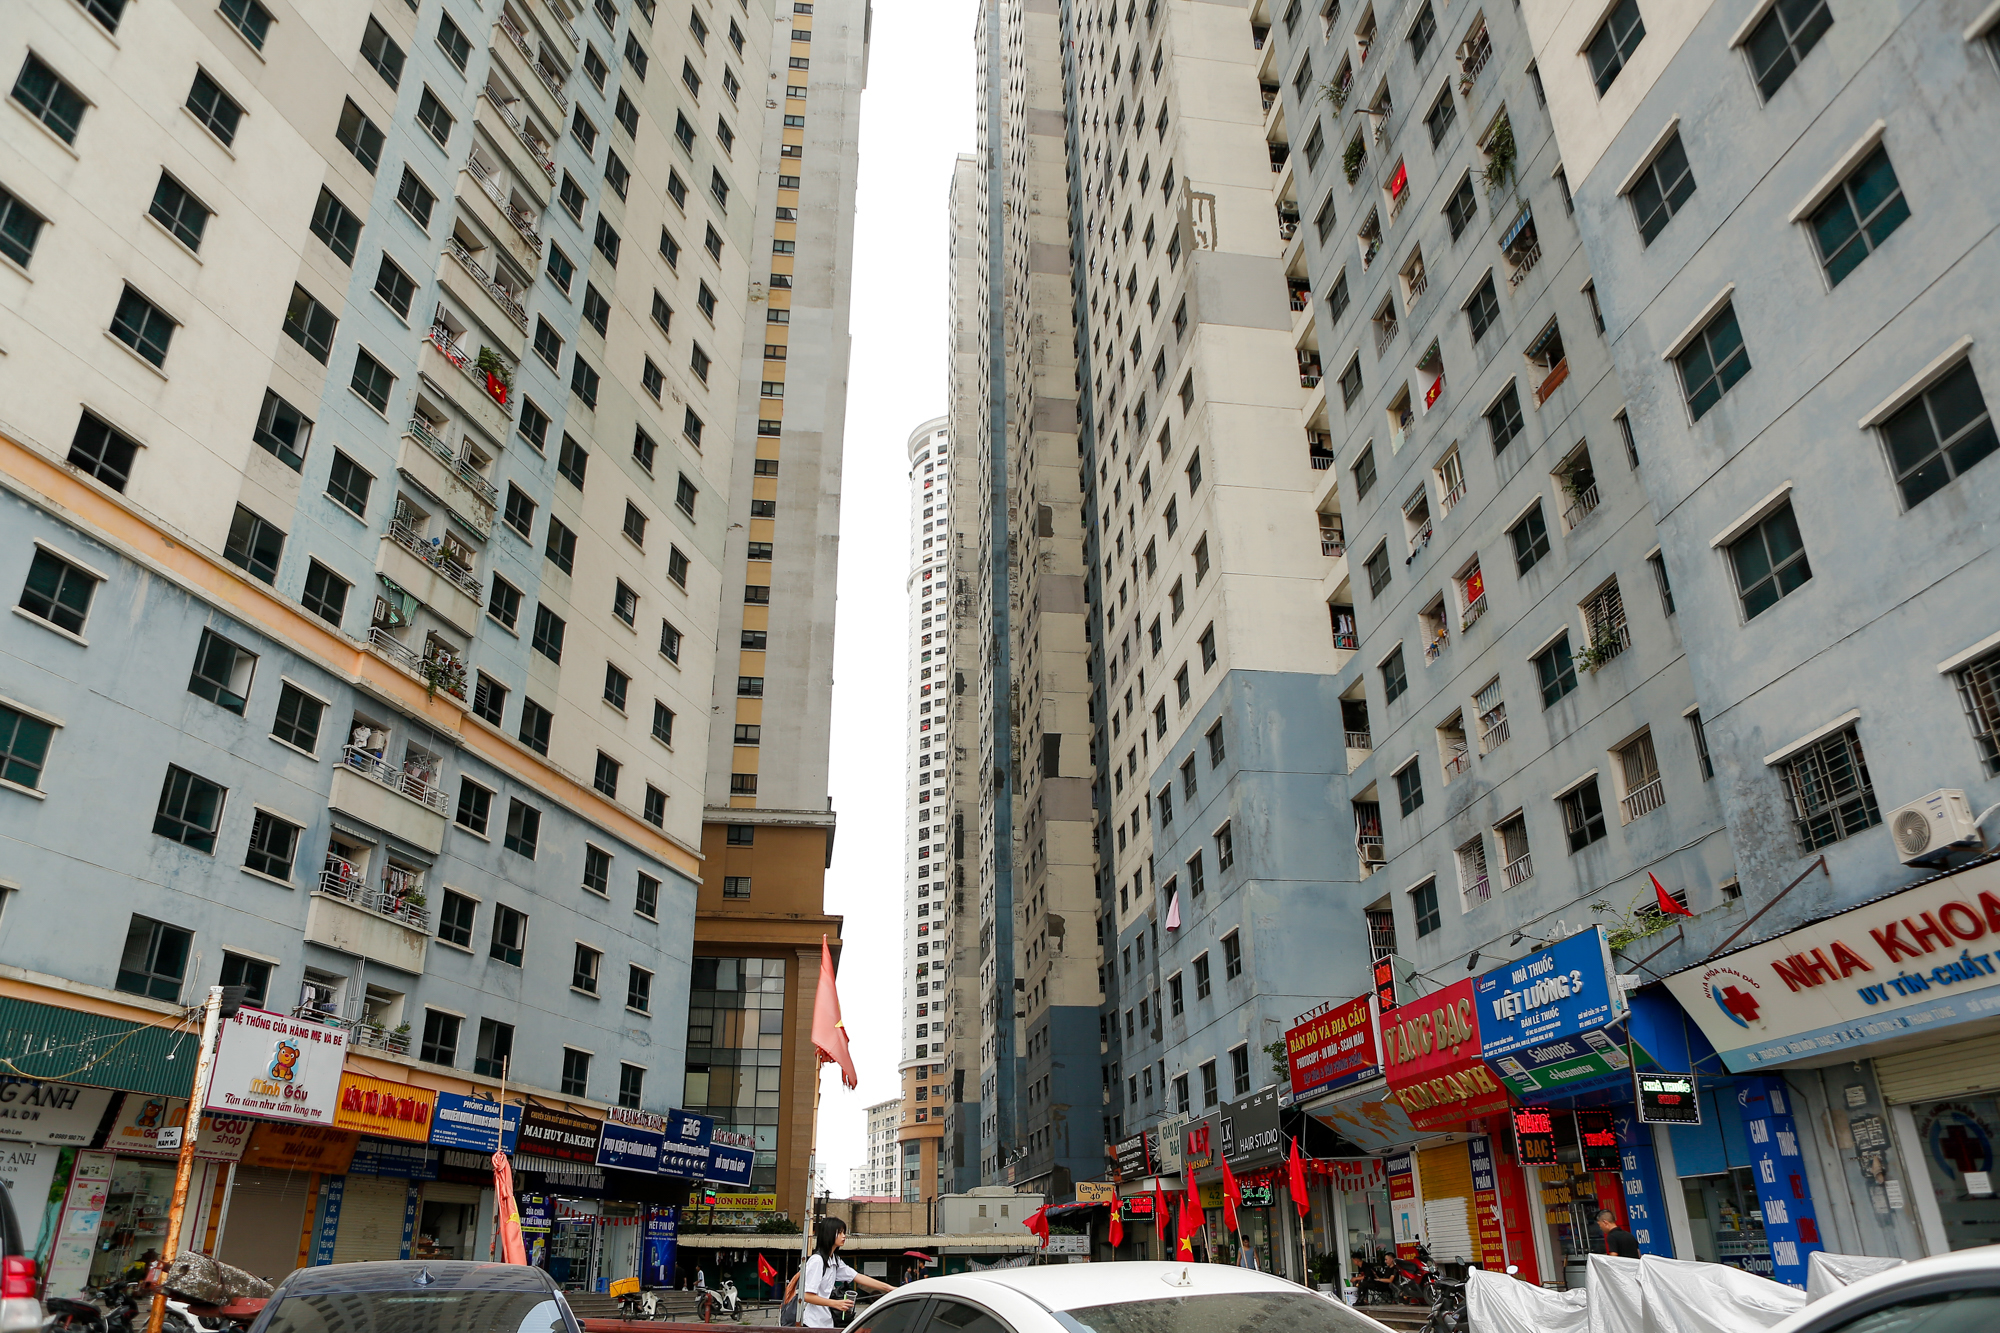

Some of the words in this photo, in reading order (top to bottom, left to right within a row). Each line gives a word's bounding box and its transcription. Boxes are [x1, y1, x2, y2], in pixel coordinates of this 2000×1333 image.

[1770, 939, 1874, 993] NHA
[1868, 889, 2000, 964] KHOA
[1512, 965, 1528, 985] NHÀ
[1528, 953, 1554, 979] THUỐC
[1492, 989, 1522, 1022] VIỆT
[1523, 975, 1570, 1011] LƯƠNG
[1569, 969, 1584, 994] 3
[1857, 983, 1890, 1006] UY
[233, 1012, 244, 1026] HỆ
[246, 1015, 271, 1030] THỐNG
[272, 1019, 287, 1034] CỬA
[289, 1024, 309, 1039] HÀNG
[311, 1030, 322, 1043] MẸ
[324, 1032, 332, 1044] VÀ
[333, 1034, 343, 1046] BÉ
[1318, 1020, 1331, 1041] VÀ
[1331, 1017, 1347, 1037] ĐỊA
[1347, 1003, 1366, 1028] CẦU
[1384, 1013, 1433, 1067] VÀNG
[1432, 998, 1473, 1055] BẠC
[1527, 1041, 1575, 1063] Salonpas
[1549, 1064, 1594, 1081] Hisamitsu
[21, 1084, 80, 1110] ANH
[283, 1083, 309, 1101] Gấu
[1396, 1081, 1439, 1114] KIM
[1429, 1065, 1498, 1107] HẠNH
[259, 1099, 276, 1109] như
[293, 1104, 309, 1117] lòng
[310, 1108, 323, 1118] mẹ
[1515, 1111, 1550, 1134] VÀNG
[1750, 1119, 1769, 1144] CAM
[164, 1130, 174, 1138] TÓC
[170, 1138, 178, 1146] NỮ
[212, 1133, 242, 1148] shop
[524, 1124, 542, 1139] MAI
[543, 1128, 563, 1142] HUY
[563, 1132, 596, 1148] BAKERY
[1240, 1136, 1255, 1153] HAIR
[1254, 1128, 1278, 1149] STUDIO
[305, 1145, 325, 1159] LAN
[1473, 1139, 1484, 1154] VĂN
[1524, 1139, 1549, 1162] BẠC
[7, 1152, 36, 1165] ANH
[443, 1150, 464, 1166] MAI
[464, 1153, 482, 1169] HUY
[1388, 1157, 1410, 1172] PHOTOCOPY
[1472, 1155, 1490, 1172] PHÒNG
[1623, 1151, 1637, 1171] TIẾT
[1759, 1152, 1776, 1183] KẾT
[1476, 1172, 1492, 1189] PHẨM
[1626, 1177, 1643, 1197] KIỆM
[408, 1187, 417, 1197] THS
[1090, 1192, 1101, 1200] 46
[1209, 1192, 1220, 1200] 42
[407, 1205, 414, 1215] BS
[735, 1196, 760, 1208] NGHỆ
[761, 1198, 774, 1206] AN
[1630, 1204, 1648, 1219] 5-7%
[1764, 1196, 1789, 1224] HÀNG
[404, 1223, 412, 1232] BV
[1636, 1229, 1650, 1245] CHO
[1773, 1237, 1799, 1266] CHÍNH
